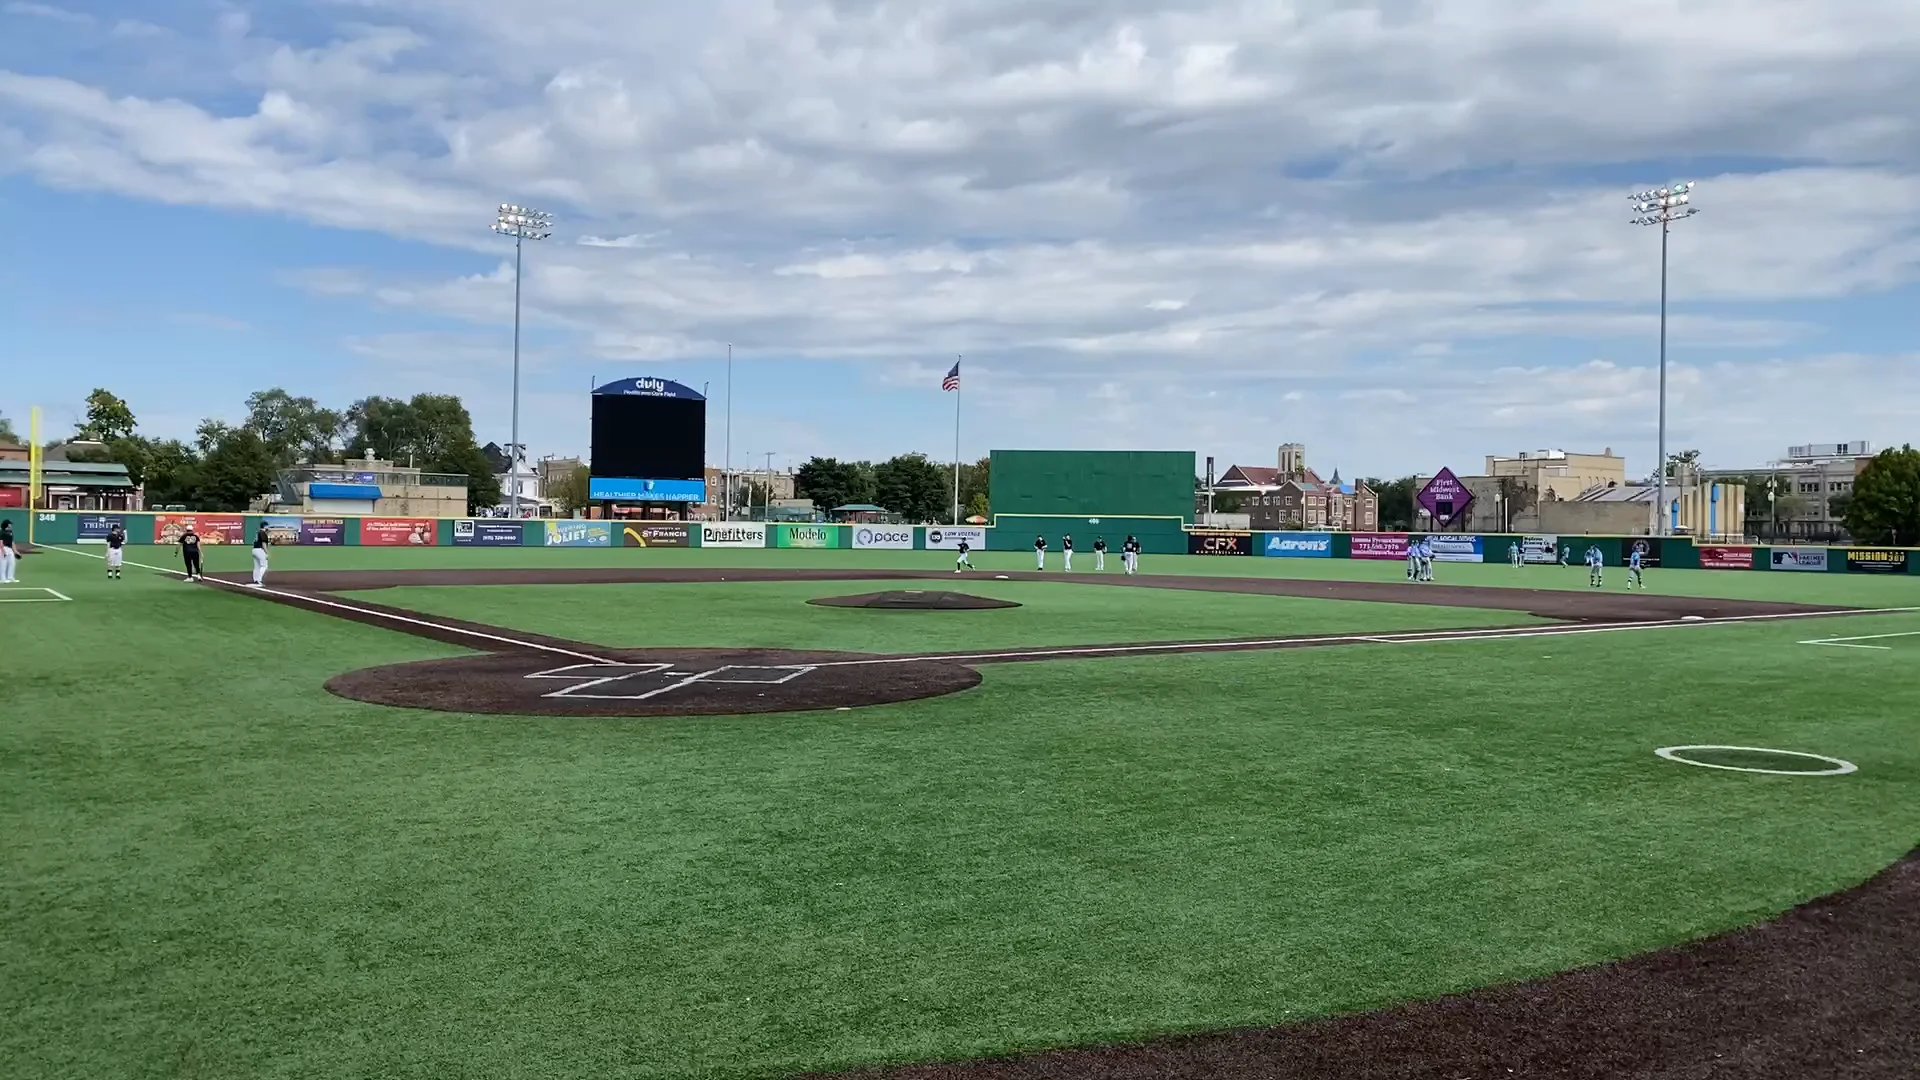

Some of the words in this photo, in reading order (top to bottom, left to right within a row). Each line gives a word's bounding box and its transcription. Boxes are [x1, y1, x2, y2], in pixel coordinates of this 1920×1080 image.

[636, 378, 664, 392] duly
[39, 514, 56, 522] 348
[547, 530, 587, 546] JOLIET
[789, 527, 827, 541] Modelo
[874, 532, 909, 543] pace
[1203, 538, 1237, 550] CFX
